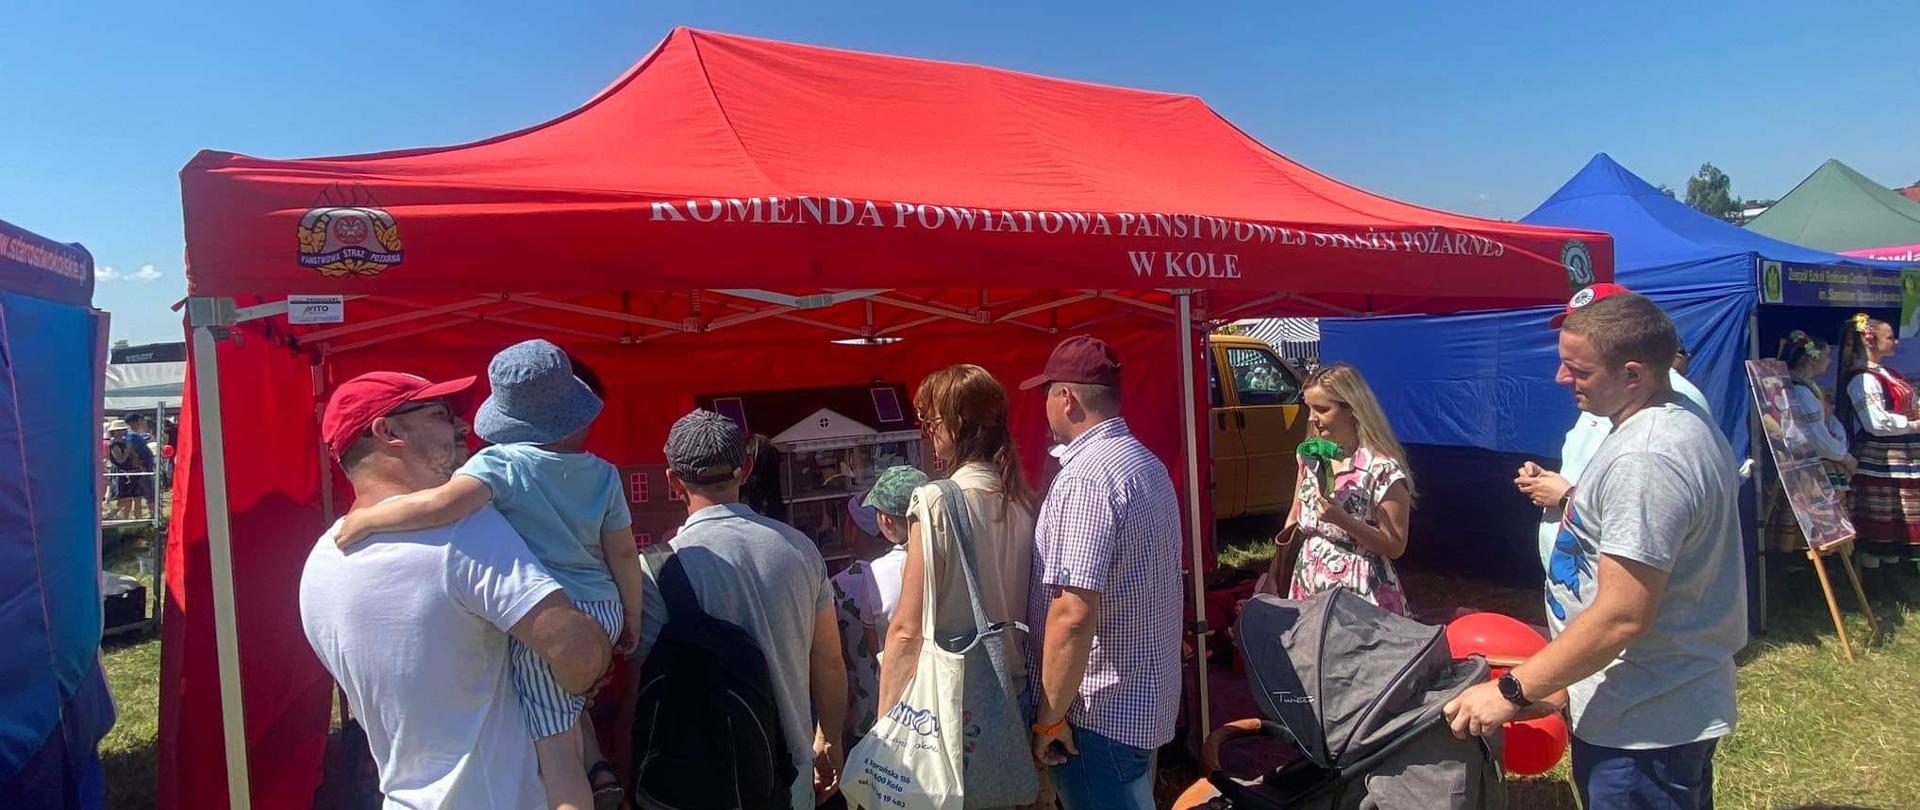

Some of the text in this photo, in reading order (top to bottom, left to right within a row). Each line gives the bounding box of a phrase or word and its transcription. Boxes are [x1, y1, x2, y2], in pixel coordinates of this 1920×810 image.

[649, 196, 885, 228] KOMENDA
[892, 201, 1113, 236] POWIATOWA
[1401, 227, 1504, 257] POŻARNEJ
[1128, 251, 1242, 279] W KOLE
